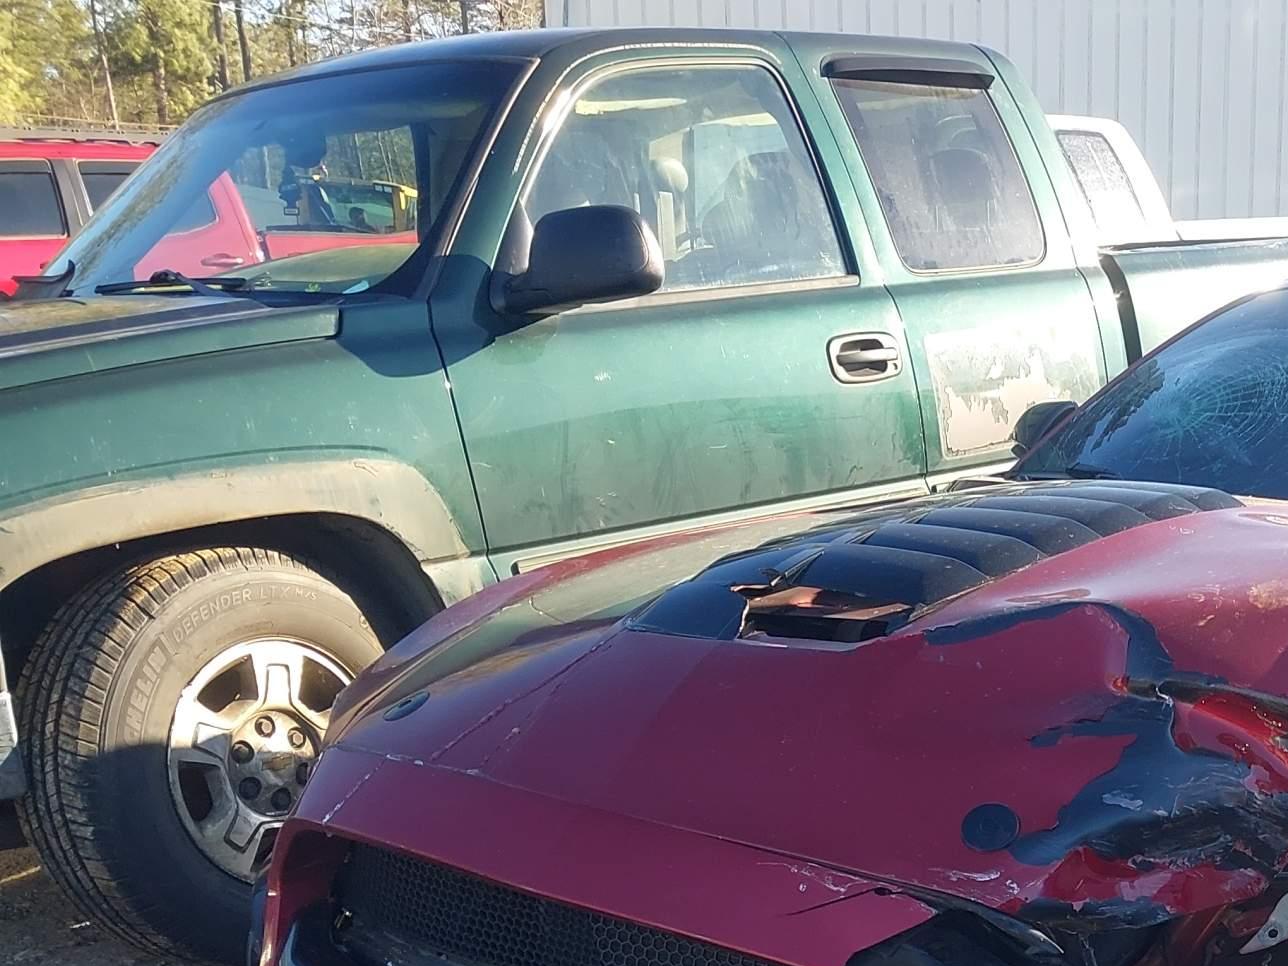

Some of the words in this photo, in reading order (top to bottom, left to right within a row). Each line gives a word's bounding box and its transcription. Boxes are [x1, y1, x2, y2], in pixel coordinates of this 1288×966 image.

[172, 588, 252, 643] DEFENDER
[258, 585, 291, 601] LTX
[122, 646, 168, 747] CHELIN
